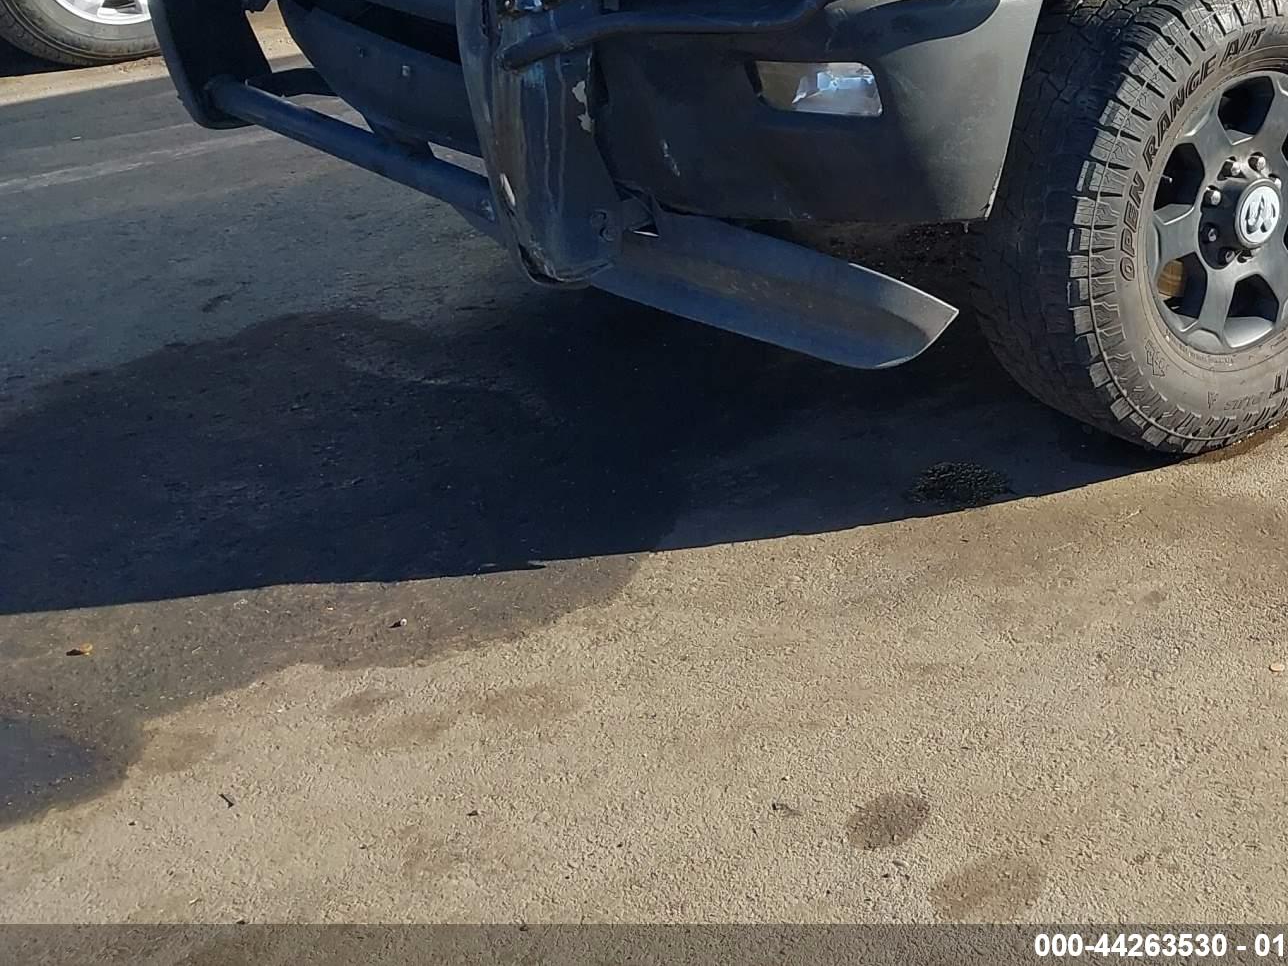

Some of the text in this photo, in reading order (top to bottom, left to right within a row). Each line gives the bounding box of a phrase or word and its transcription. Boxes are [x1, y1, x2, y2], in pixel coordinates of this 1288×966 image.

[1119, 170, 1147, 282] OPEN
[1142, 54, 1217, 171] RANGE
[1219, 26, 1266, 67] A/T
